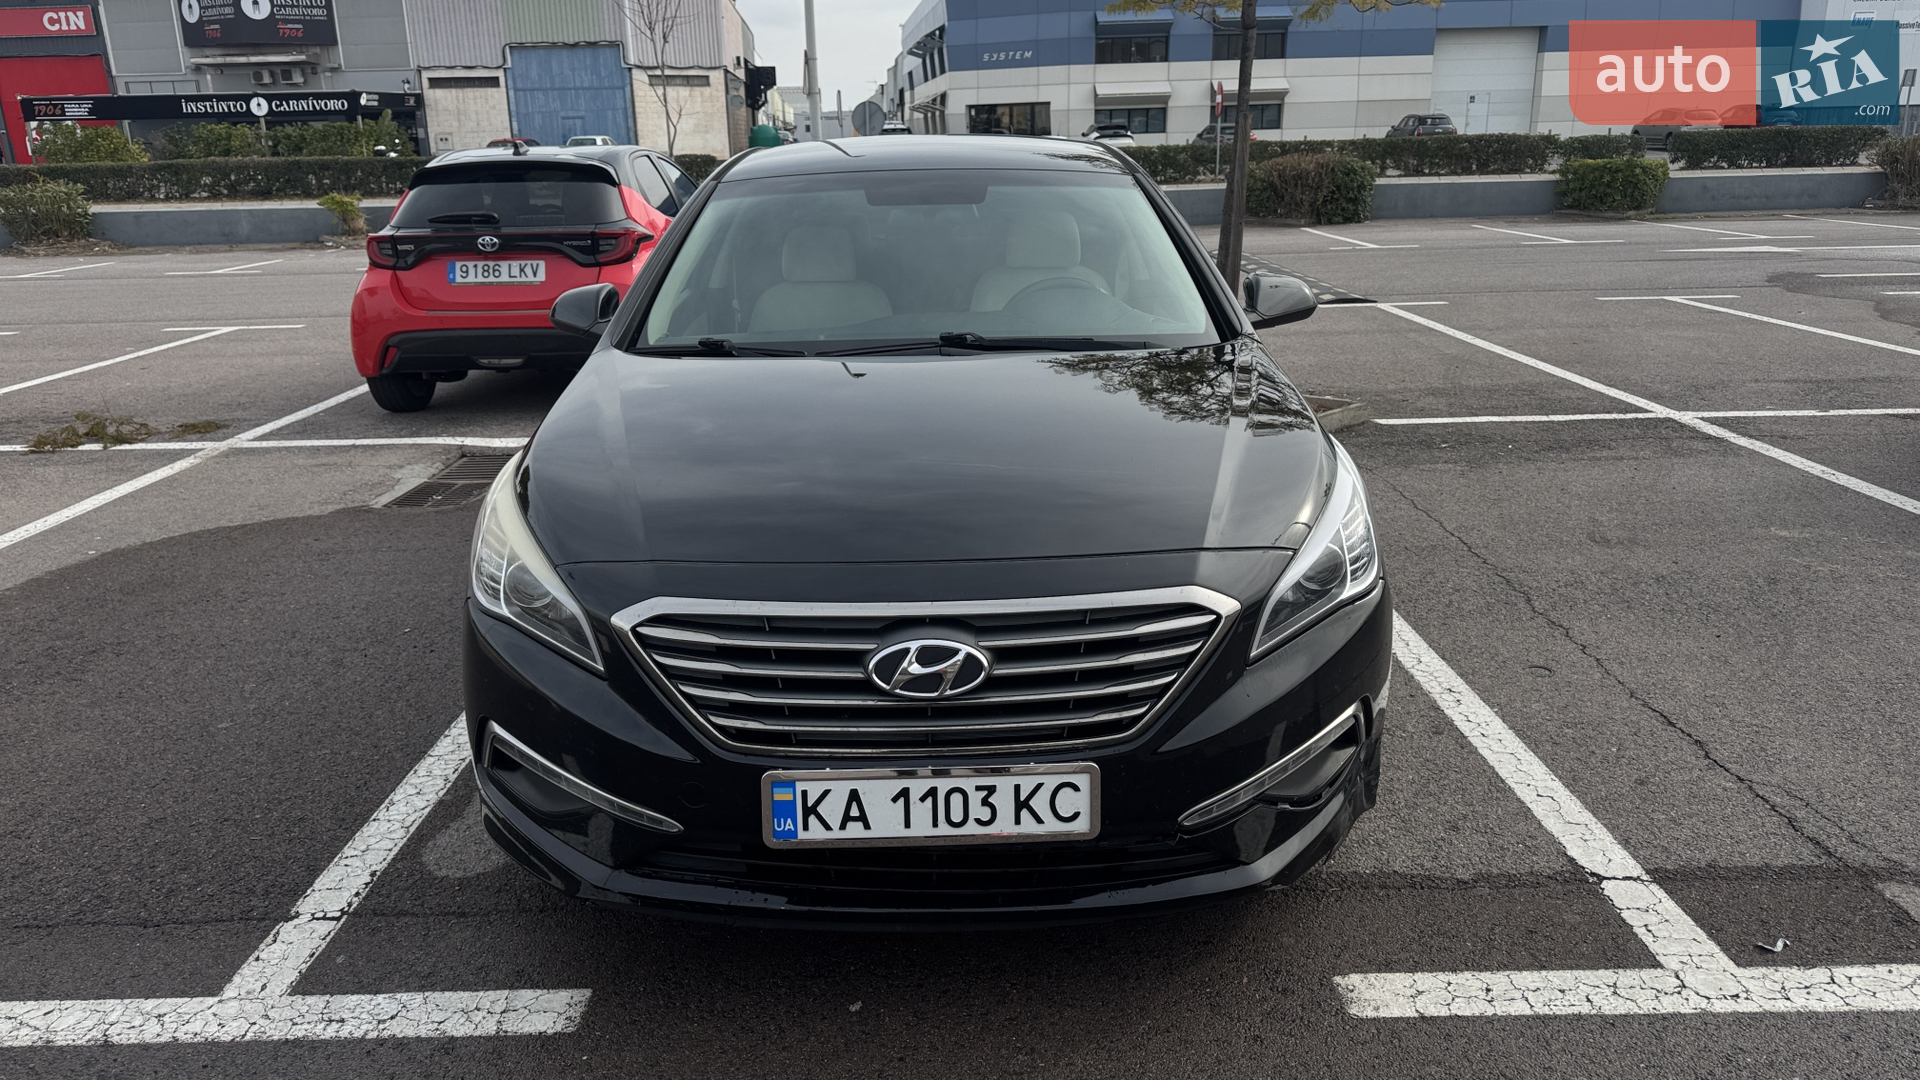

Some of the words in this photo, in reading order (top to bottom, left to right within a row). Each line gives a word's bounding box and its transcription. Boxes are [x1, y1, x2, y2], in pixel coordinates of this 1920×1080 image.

[273, 6, 327, 15] CARNÍVORO
[42, 11, 86, 31] CIN
[279, 29, 304, 37] 1906
[982, 51, 1033, 61] SYSTEM
[33, 104, 62, 116] 1906
[271, 97, 349, 112] CARNÍVORO
[460, 264, 502, 279] 9186
[508, 263, 540, 278] LKV
[801, 788, 872, 831] KA
[890, 784, 998, 829] 1103
[1013, 781, 1082, 826] KC
[774, 817, 795, 832] UA
